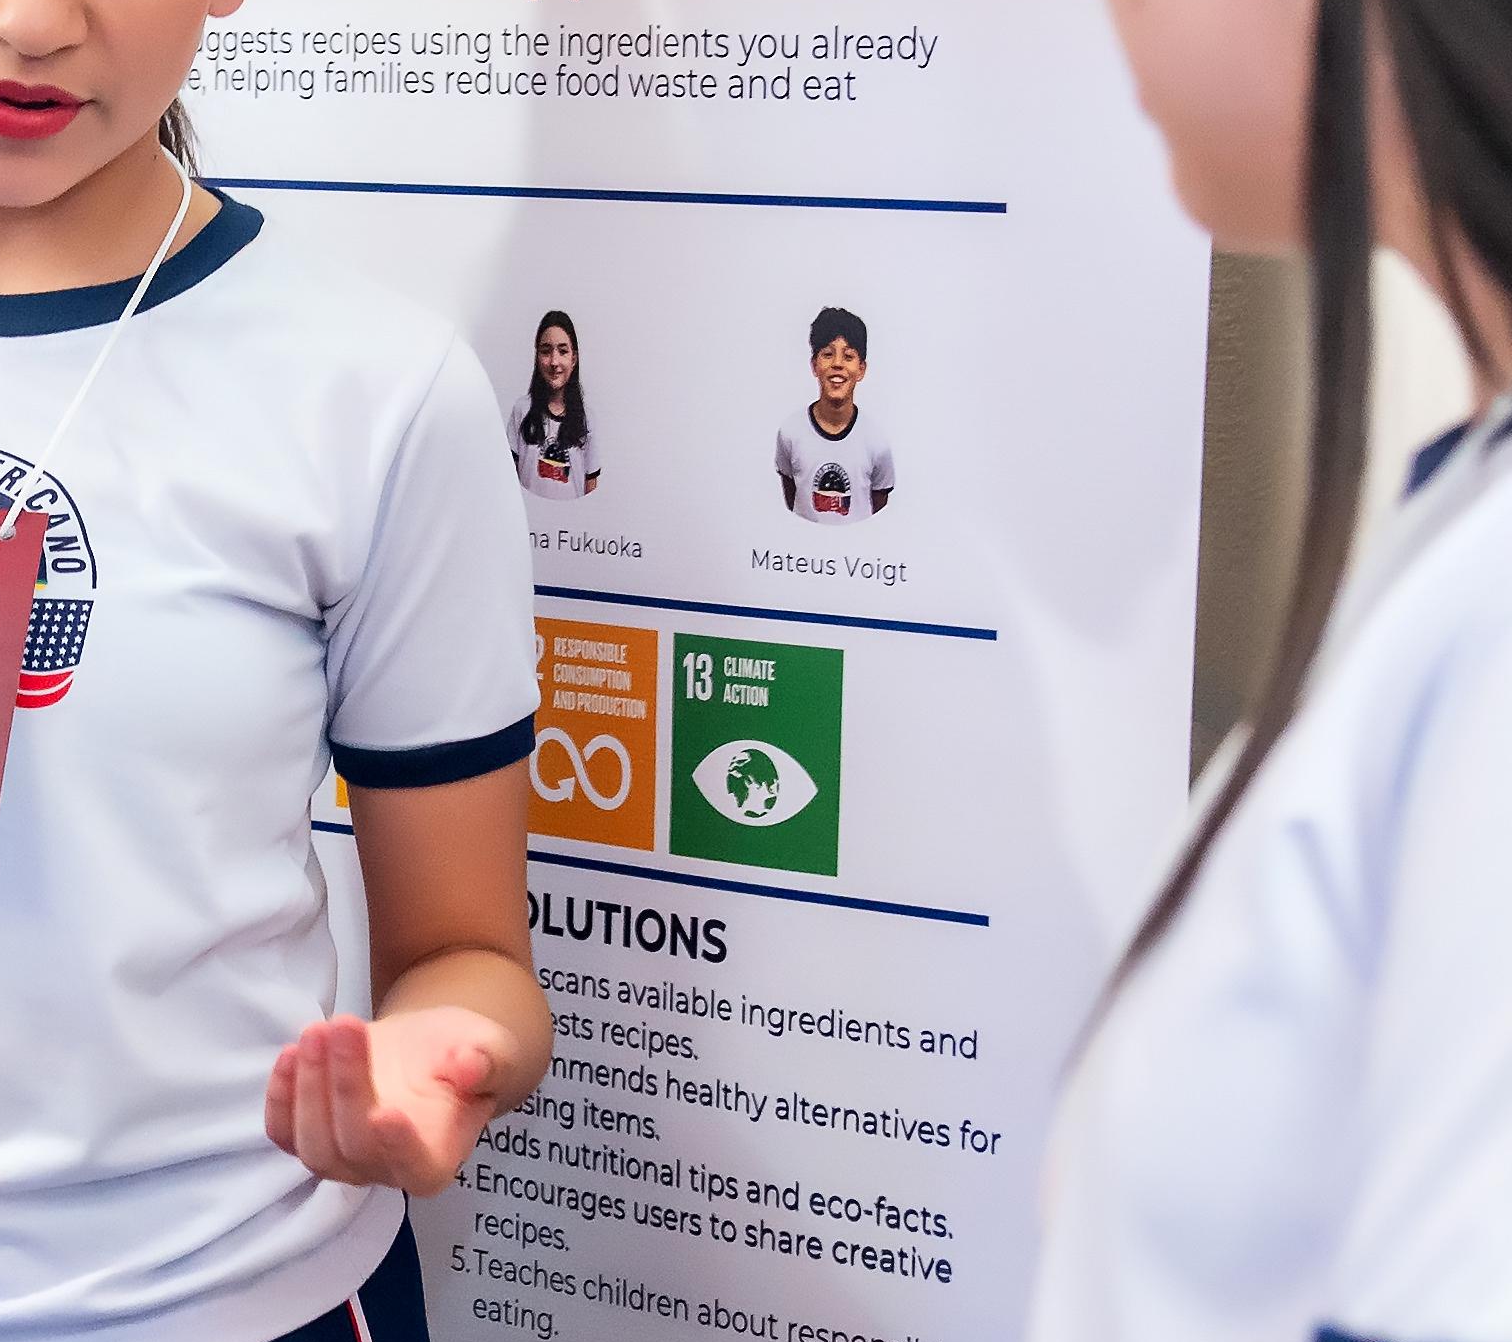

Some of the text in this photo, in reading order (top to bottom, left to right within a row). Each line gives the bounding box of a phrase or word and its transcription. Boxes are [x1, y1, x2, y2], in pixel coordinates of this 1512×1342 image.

[197, 24, 939, 69] ggests recipes using the ingredients you already
[214, 60, 315, 100] helping
[325, 61, 435, 97] families
[444, 63, 548, 97] reduce
[555, 63, 620, 98] food
[628, 68, 718, 99] waste
[727, 65, 792, 100] and
[802, 69, 857, 101] eat
[557, 529, 643, 559] Fukuoka
[751, 547, 907, 586] Mateus Voigt
[553, 636, 628, 665] RESPONSIBLE
[723, 655, 777, 682] CLIMATE
[553, 662, 633, 692] CONSUMPTION
[682, 651, 715, 702] 13
[722, 682, 770, 709] ACTION
[576, 691, 648, 721] PRODUCTION
[538, 965, 979, 1061] scans available ingredients and
[601, 1021, 700, 1061] recipes.
[512, 1089, 661, 1141] sing items.
[665, 1070, 769, 1124] healthy
[774, 1091, 952, 1148] alternatives
[958, 1118, 1002, 1156] for
[476, 1122, 954, 1241] Adds nutritional tips and eco-facts.
[475, 1212, 571, 1252] recipes.
[633, 1199, 703, 1237] users
[708, 1212, 738, 1244] to
[743, 1220, 824, 1261] share
[831, 1235, 954, 1285] creative
[472, 1295, 560, 1341] eating.
[582, 1273, 690, 1322] children
[696, 1298, 779, 1341] about
